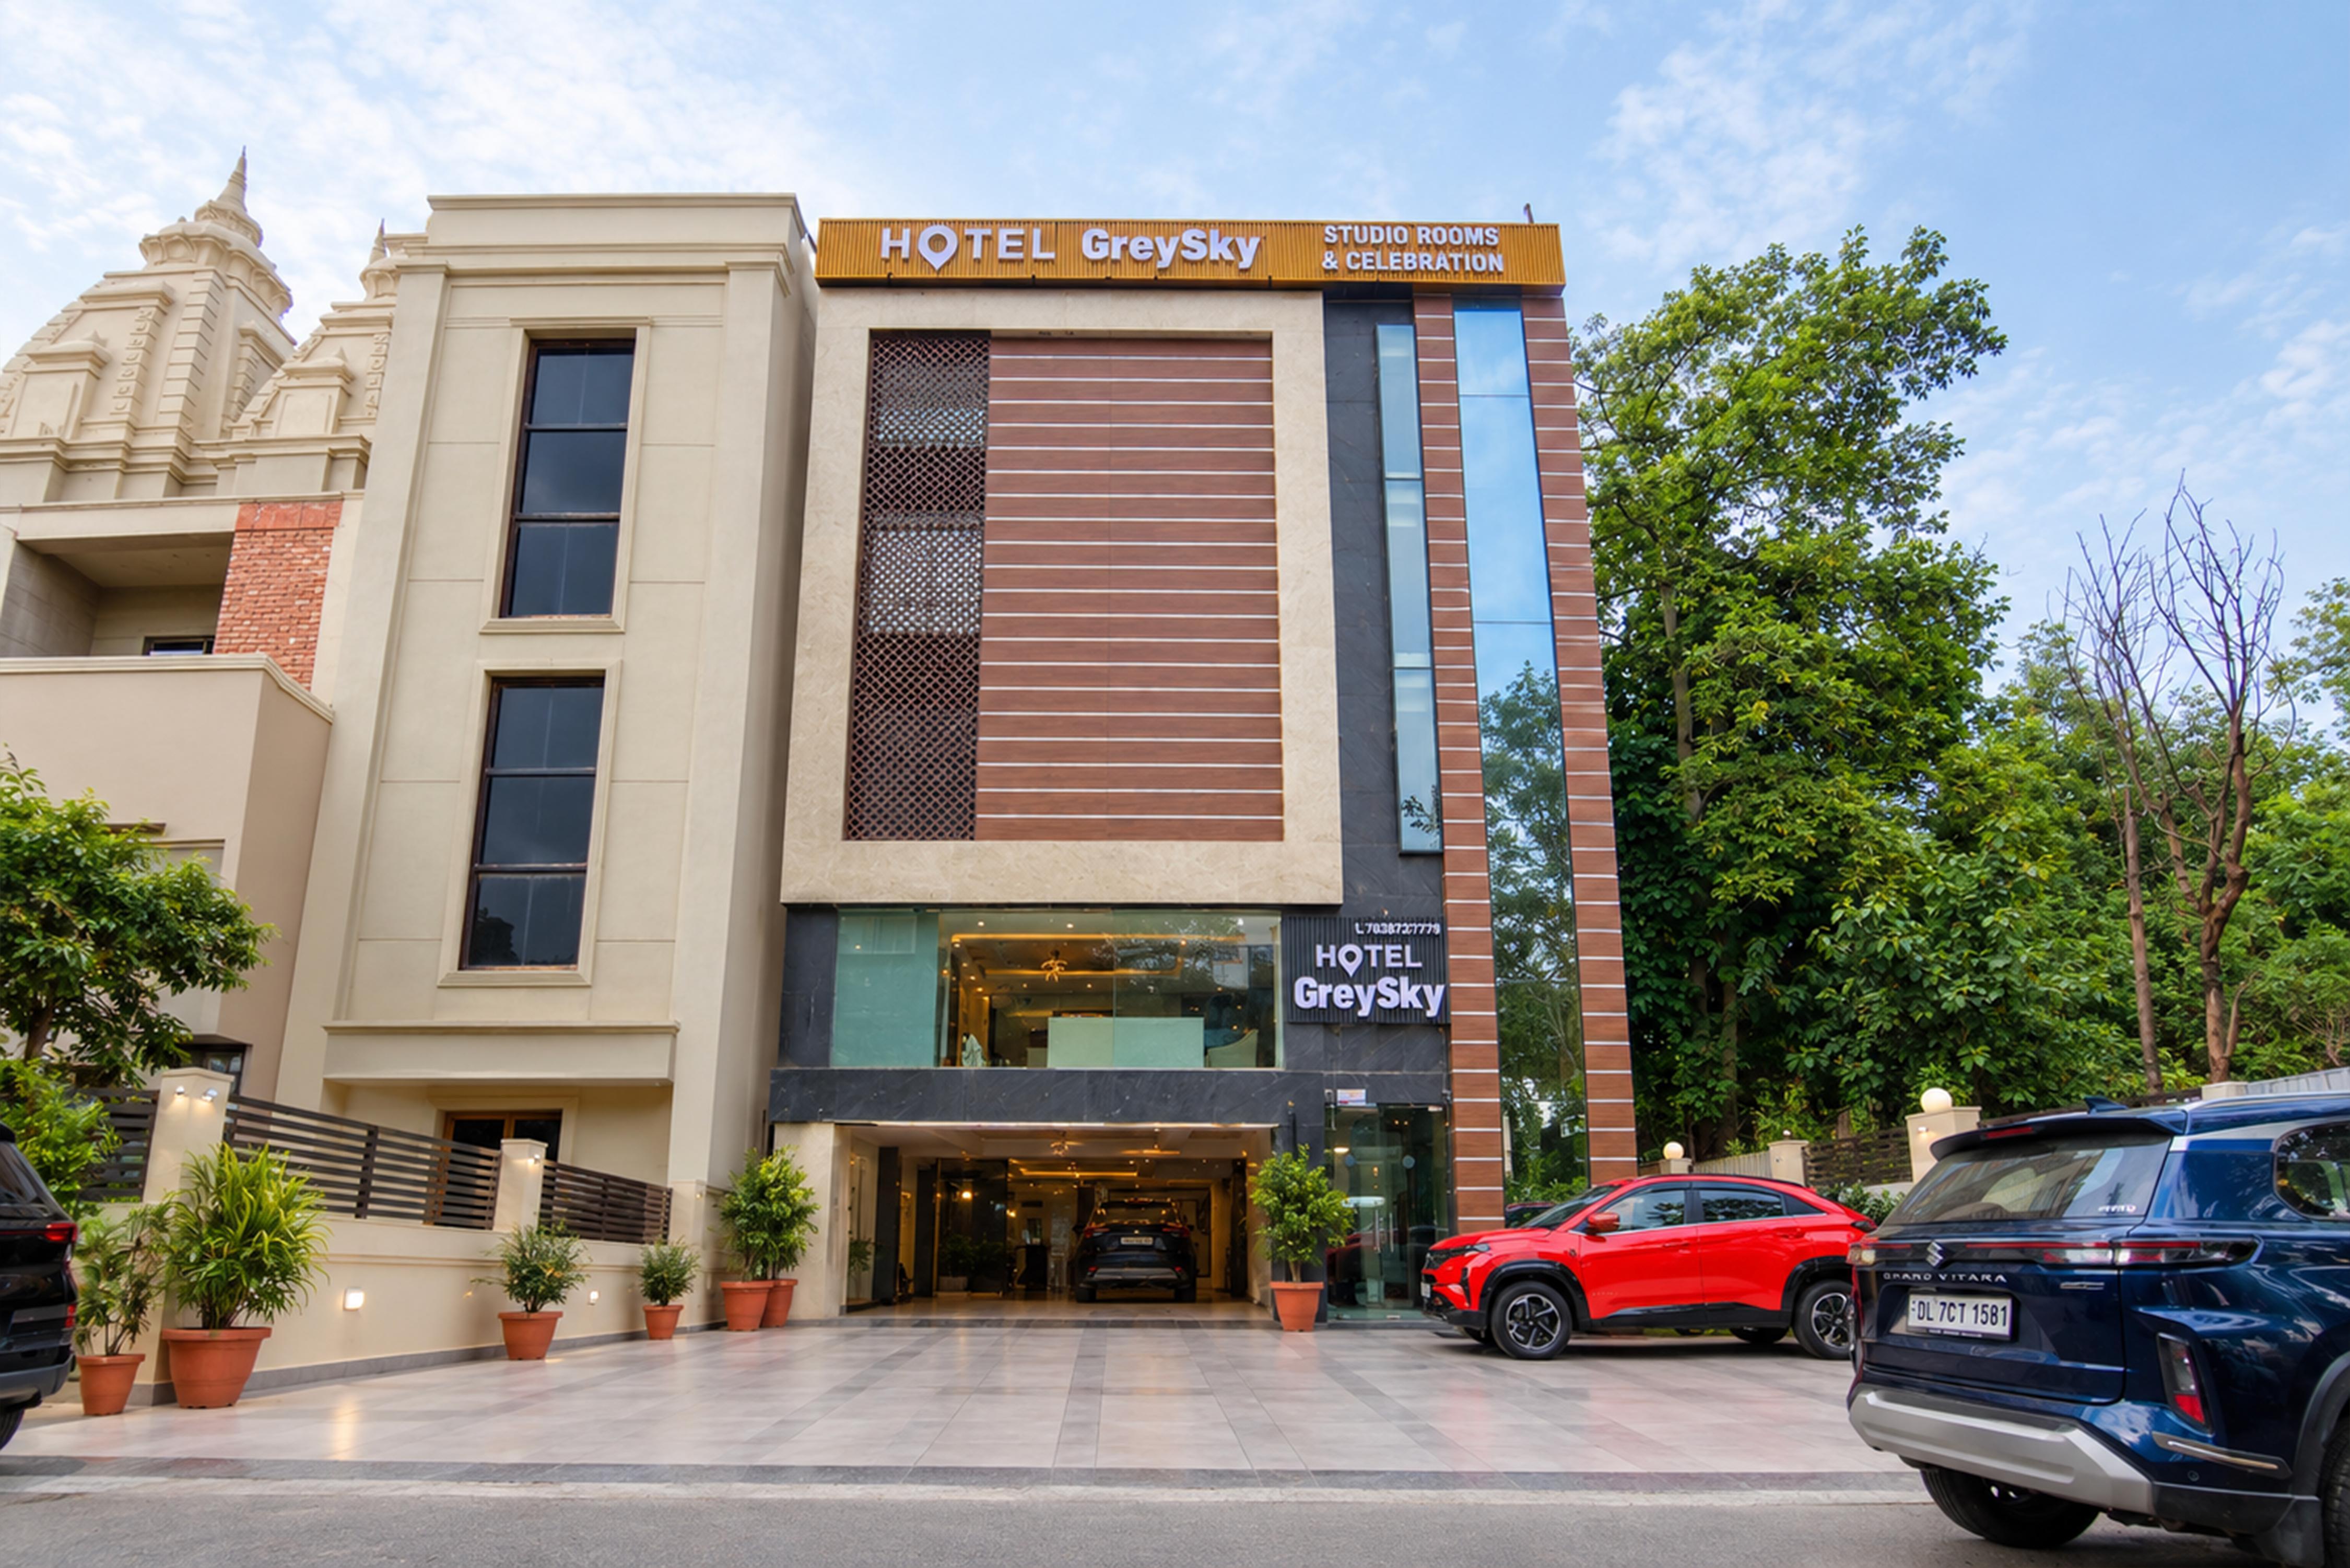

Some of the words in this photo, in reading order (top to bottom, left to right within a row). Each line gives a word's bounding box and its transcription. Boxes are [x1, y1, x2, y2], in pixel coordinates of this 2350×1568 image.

[881, 225, 1055, 270] HOTEL
[1082, 228, 1260, 269] GreySky
[1324, 225, 1408, 245] STUDIO
[1417, 227, 1499, 246] ROOMS
[1322, 251, 1339, 270] &
[1346, 252, 1503, 272] CELEBRATION
[1315, 943, 1423, 977] HOTEL
[1294, 976, 1446, 1018] GreySky
[1938, 1273, 2007, 1283] VITARA
[1917, 1301, 1934, 1322] DL
[1939, 1301, 1967, 1324] 7CT
[1972, 1303, 2007, 1327] 1581
